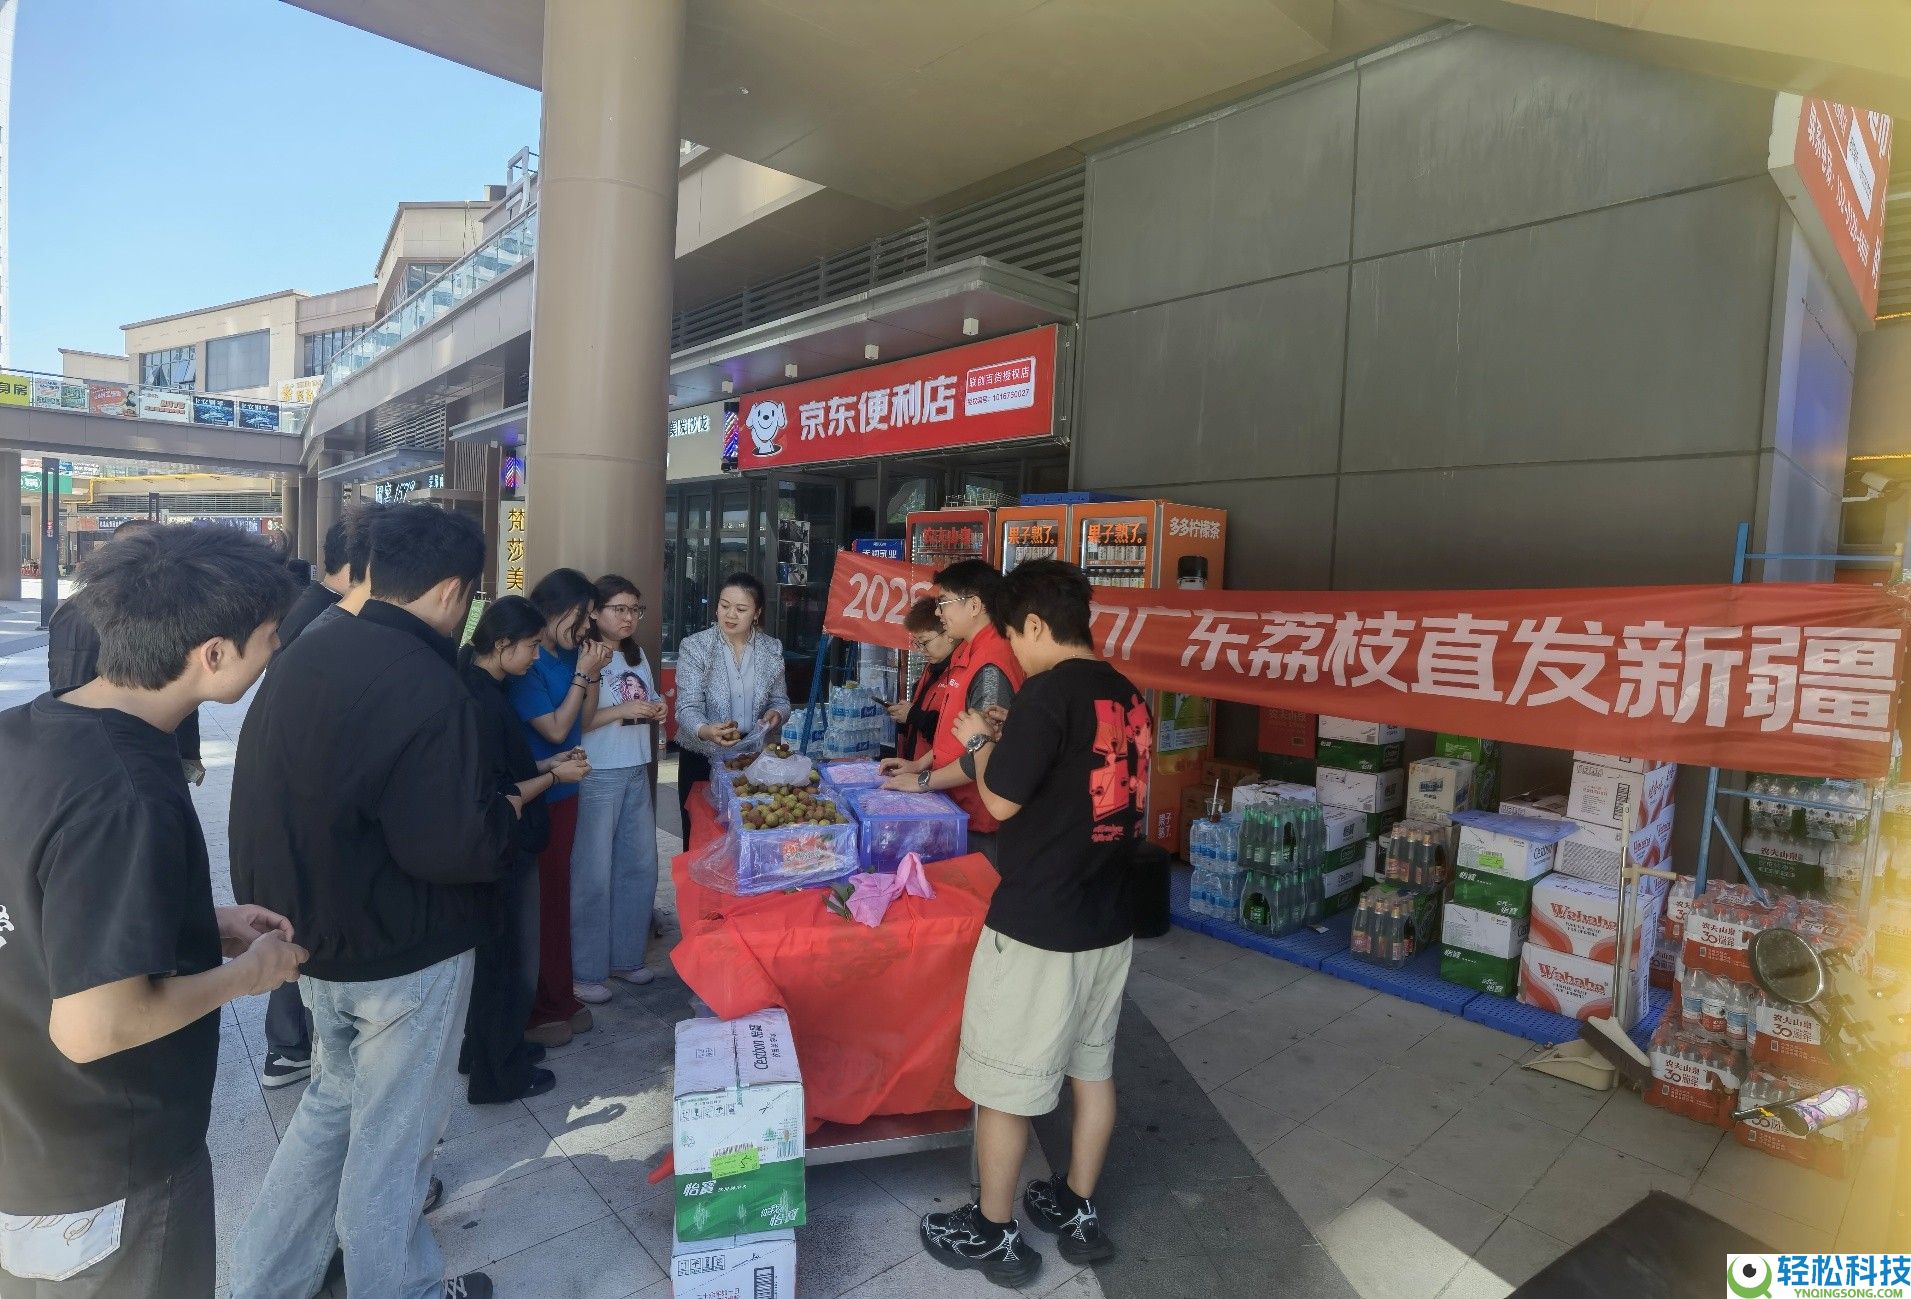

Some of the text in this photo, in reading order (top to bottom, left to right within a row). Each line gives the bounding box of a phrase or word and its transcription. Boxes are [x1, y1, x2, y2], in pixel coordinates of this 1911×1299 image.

[798, 375, 958, 440] 京东便利店
[1169, 516, 1221, 540] 多多柠檬茶
[1701, 921, 1736, 937] 农夫山泉
[1537, 963, 1607, 996] Wahaha
[1772, 1013, 1812, 1029] 农夫山泉
[1665, 1059, 1700, 1075] 农夫山泉
